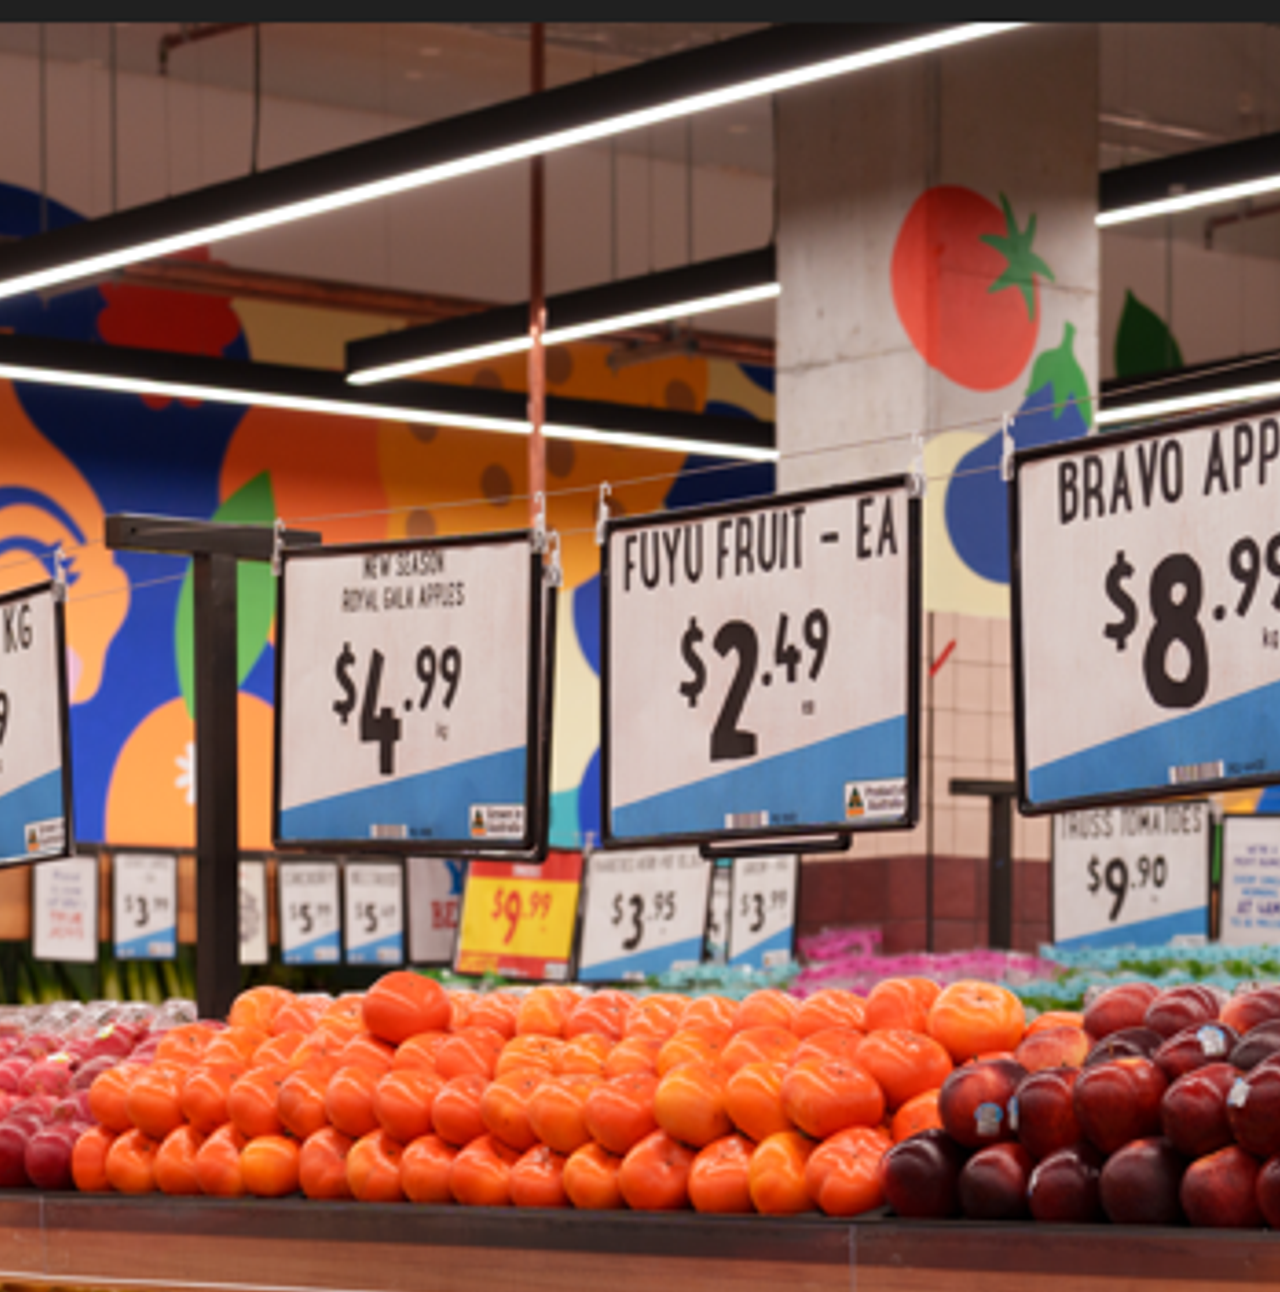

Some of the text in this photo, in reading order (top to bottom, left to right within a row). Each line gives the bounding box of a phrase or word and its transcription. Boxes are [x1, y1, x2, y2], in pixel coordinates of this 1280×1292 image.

[1058, 439, 1183, 524] BRAVO
[363, 551, 444, 579] NEW SEASON
[624, 524, 703, 591] FUYU
[716, 506, 805, 580] FRUIT
[856, 496, 898, 559] EA
[419, 582, 465, 607] APPLES
[3, 604, 33, 655] KG
[333, 642, 462, 776] $4.99
[679, 608, 829, 763] $2.49
[1119, 804, 1201, 837] TOMATOES
[490, 887, 553, 945] $9.99
[1087, 854, 1168, 922] $9.90
[610, 890, 676, 950] $3.95
